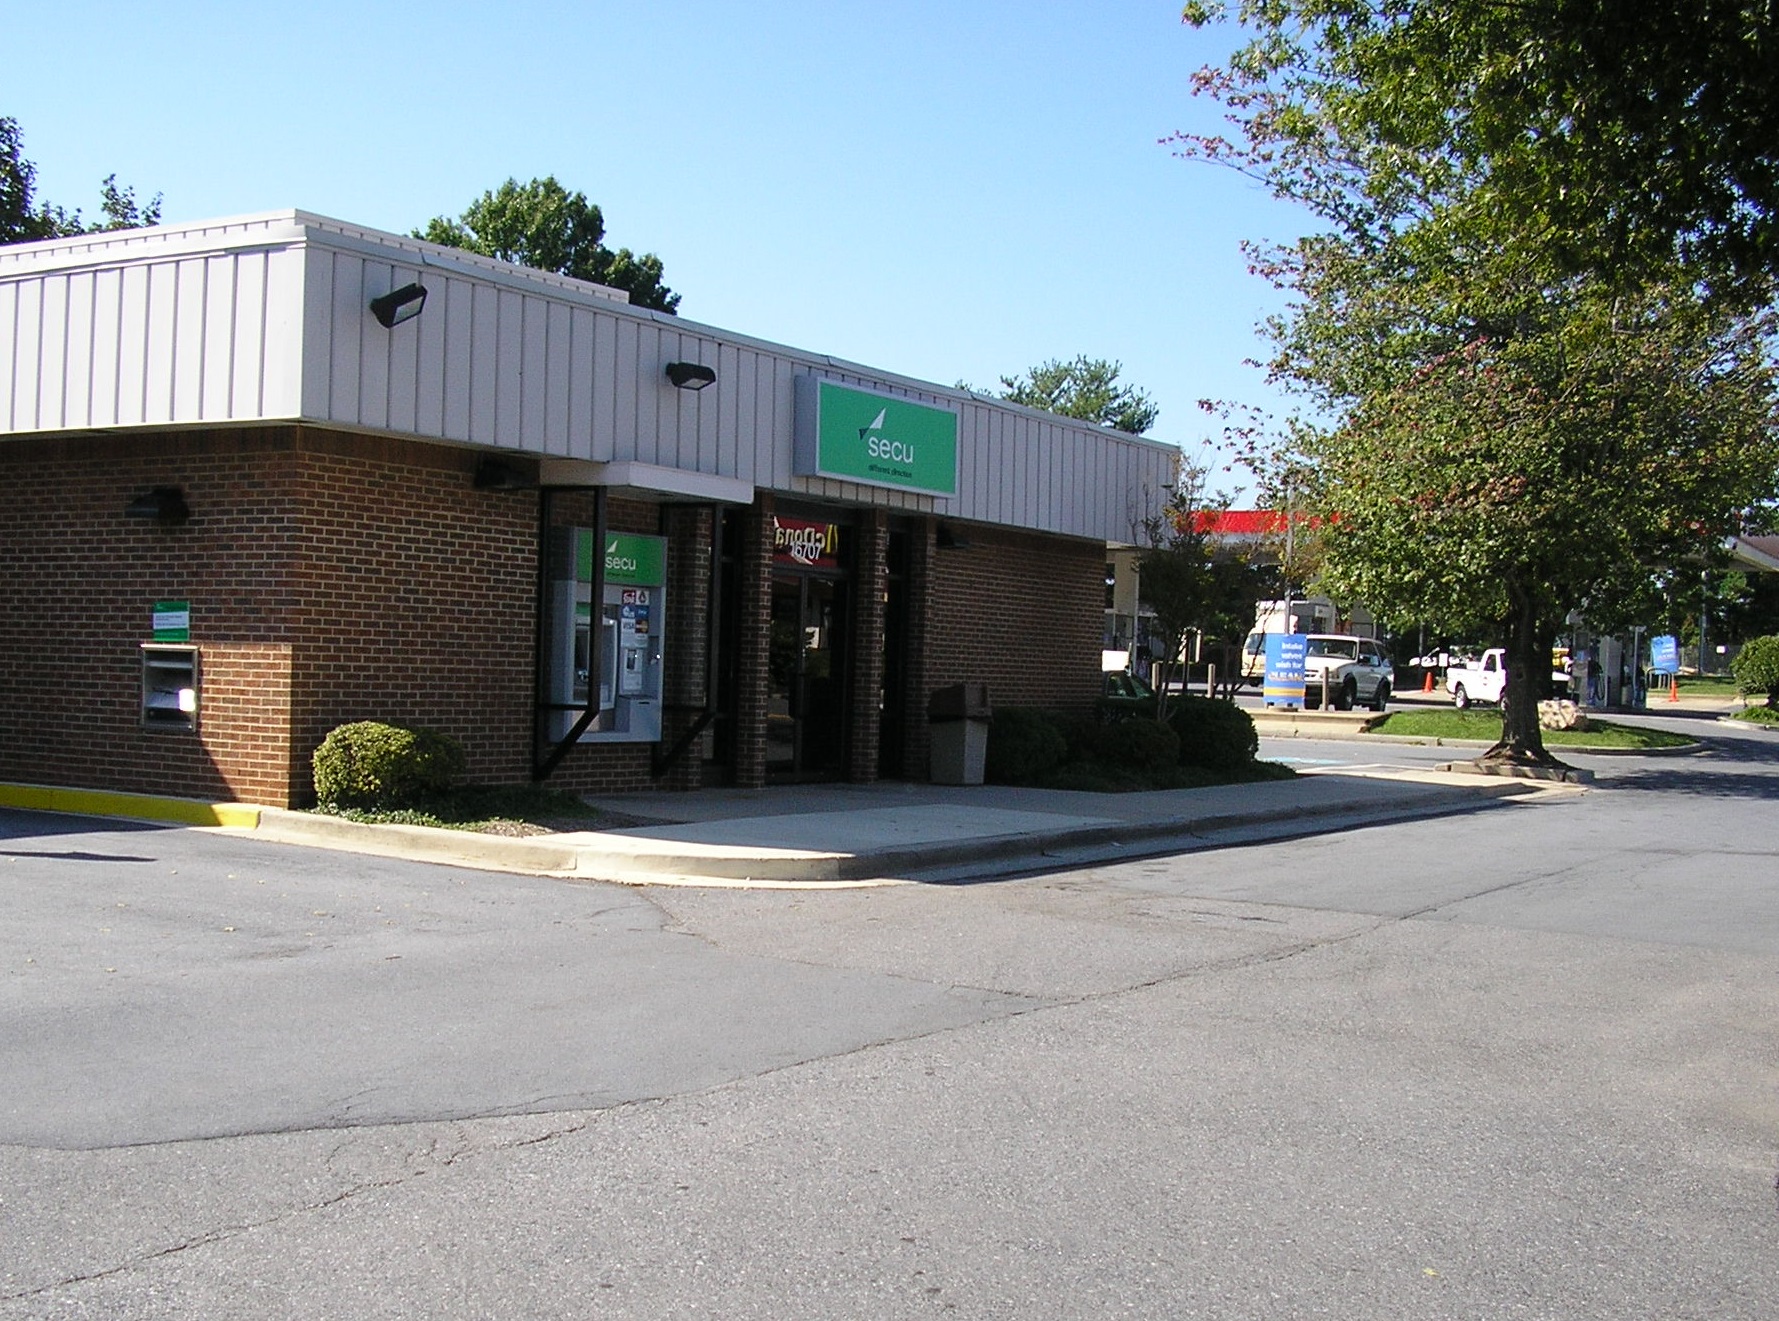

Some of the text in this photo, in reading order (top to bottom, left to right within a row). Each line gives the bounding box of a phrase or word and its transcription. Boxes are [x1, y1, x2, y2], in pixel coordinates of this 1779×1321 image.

[868, 436, 914, 463] secu
[790, 541, 821, 560] 16707
[605, 557, 636, 570] secu
